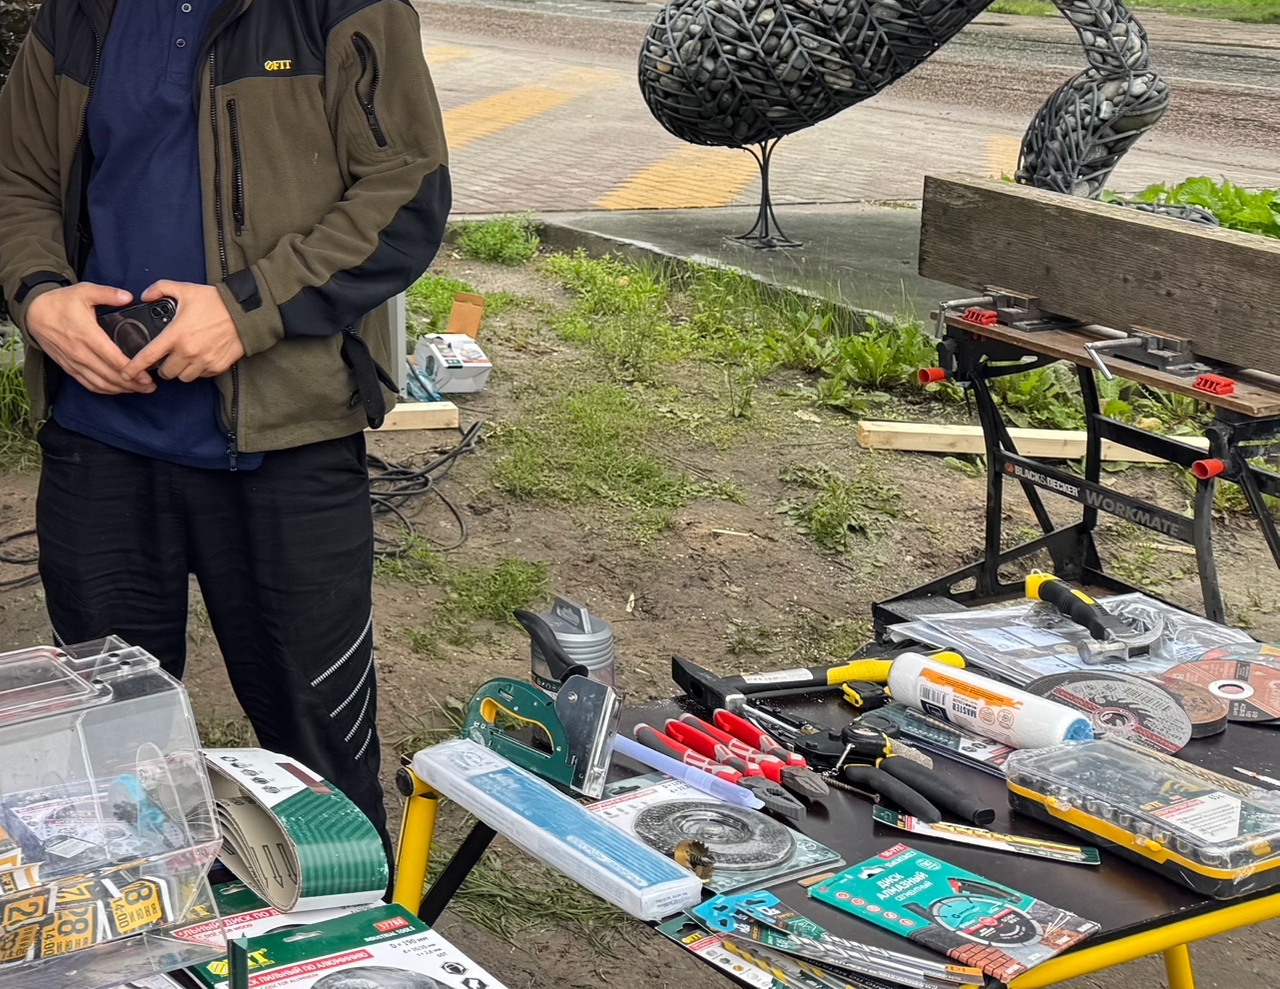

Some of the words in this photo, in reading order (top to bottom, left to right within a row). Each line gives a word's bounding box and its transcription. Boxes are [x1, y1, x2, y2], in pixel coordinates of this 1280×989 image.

[1085, 489, 1179, 536] WORKMATE
[952, 703, 977, 718] MASTER
[877, 872, 905, 889] ДИСК
[878, 871, 930, 901] АЛМАЗНЫЙ
[183, 920, 222, 937] ЛЬНЫЙ
[224, 914, 253, 927] ДИСК
[254, 911, 269, 920] ПО
[364, 931, 396, 942] INDUSTRIAL
[395, 926, 416, 937] TOOLS
[258, 965, 303, 984] ПИЛЬНЫЙ
[303, 962, 316, 972] ПО
